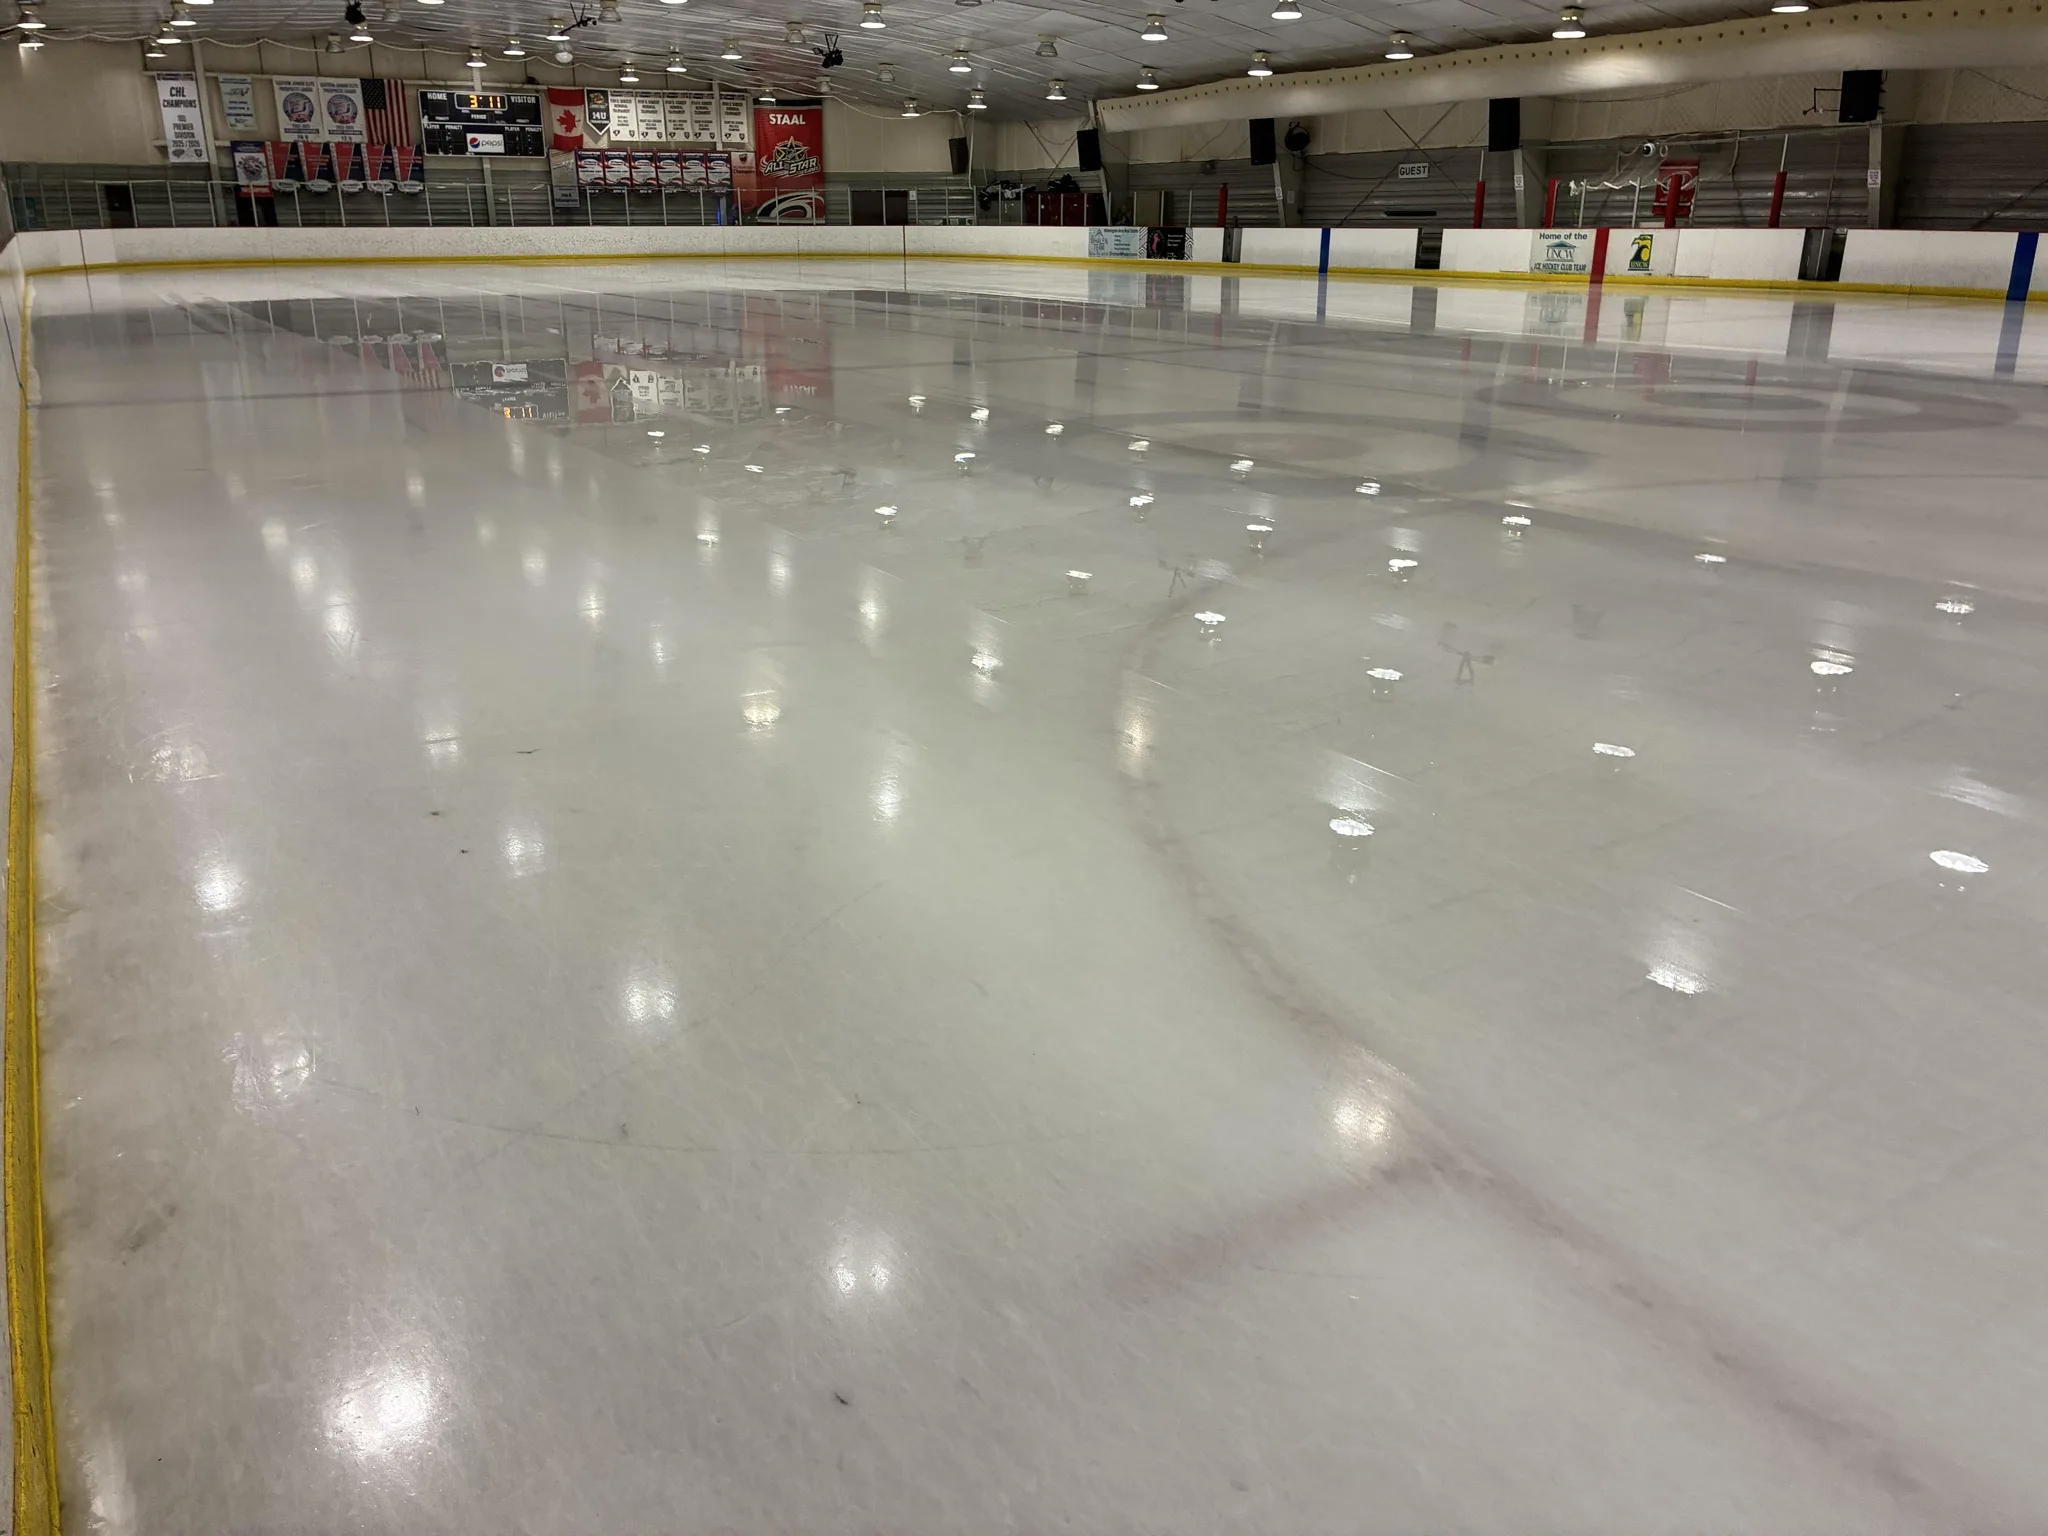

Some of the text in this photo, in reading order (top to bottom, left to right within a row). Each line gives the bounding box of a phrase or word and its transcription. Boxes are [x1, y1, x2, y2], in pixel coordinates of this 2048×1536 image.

[169, 86, 186, 97] CHL
[427, 92, 448, 100] HOME
[162, 99, 197, 108] CHAMPIONS
[468, 94, 501, 108] 3:11
[510, 95, 536, 104] VISITOR
[769, 113, 806, 125] STAAL
[481, 139, 503, 148] pepsi
[764, 157, 817, 175] ALL STAR
[1399, 165, 1427, 176] GUEST
[1539, 232, 1587, 240] Home of the
[1546, 248, 1575, 260] UNCW
[1542, 263, 1560, 271] HOCKEY
[1560, 263, 1572, 271] CLUB
[1573, 264, 1587, 272] TEAM
